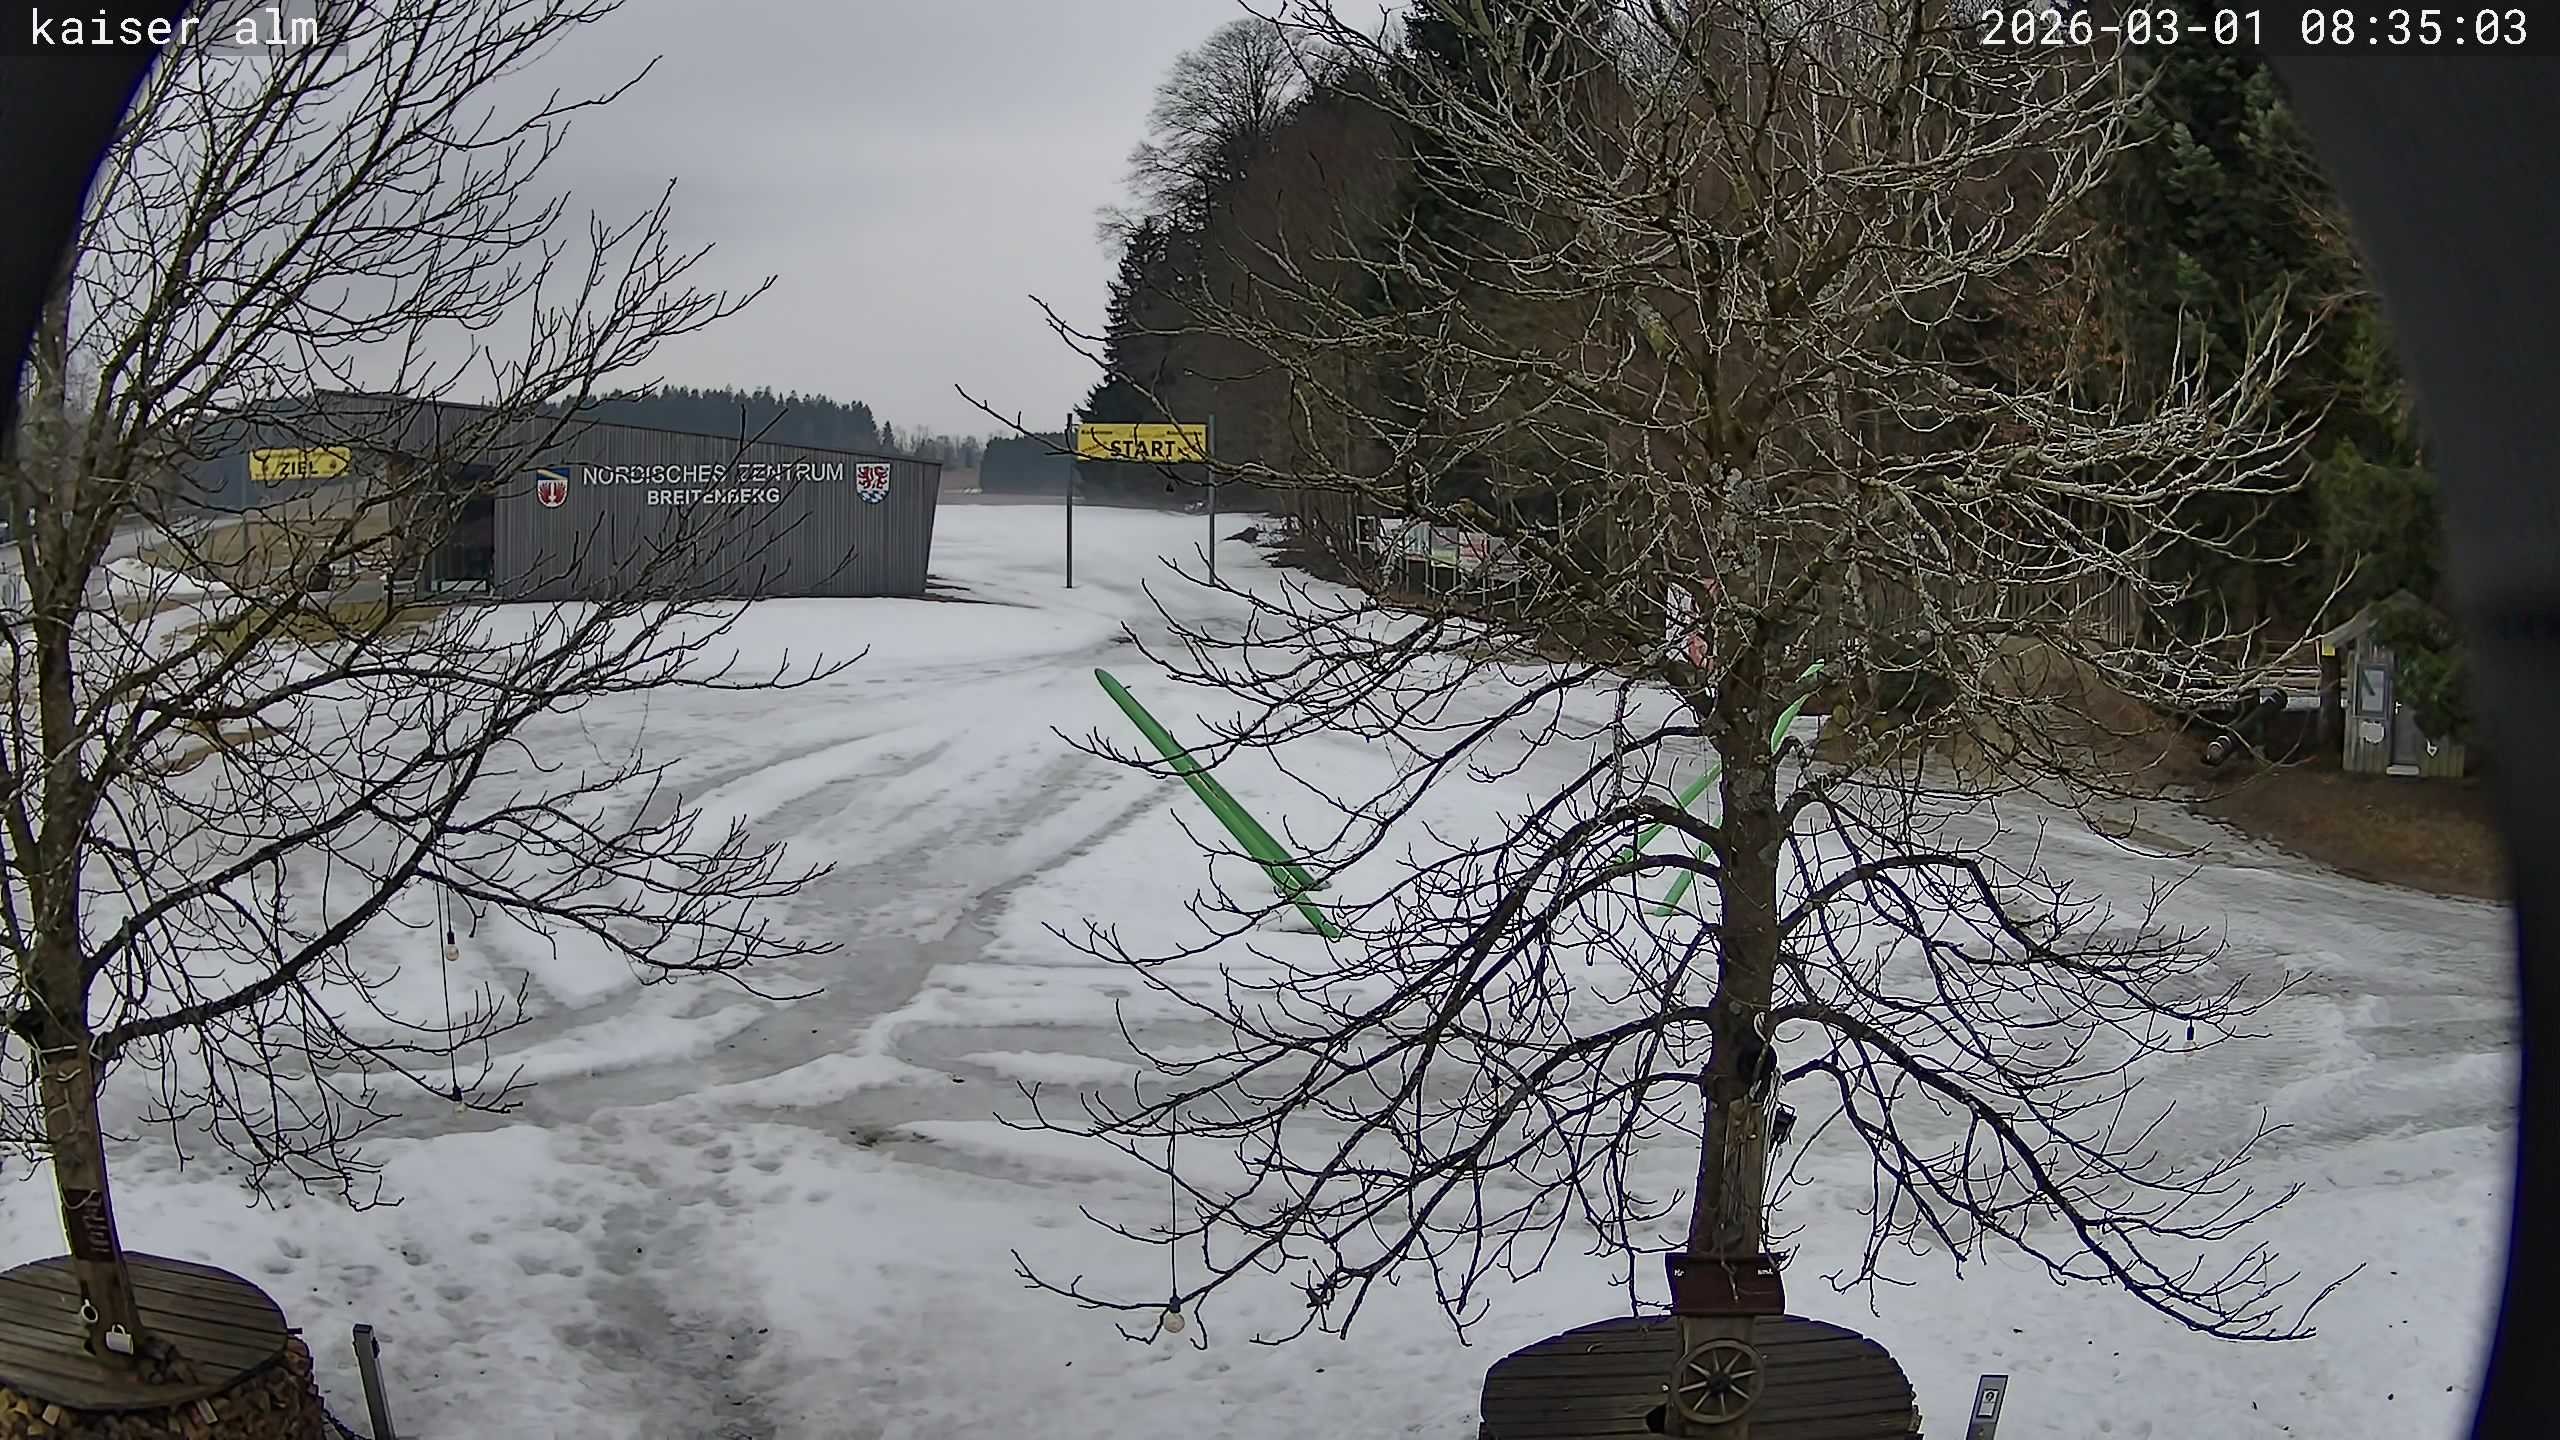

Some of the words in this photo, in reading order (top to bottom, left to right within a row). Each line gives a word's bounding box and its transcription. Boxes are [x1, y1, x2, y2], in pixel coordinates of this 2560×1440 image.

[1110, 440, 1176, 458] START
[280, 461, 318, 476] ZIEL
[583, 463, 727, 485] NORDISCHES
[737, 462, 844, 482] ZENTRUM
[647, 487, 780, 505] BREITENBERG
